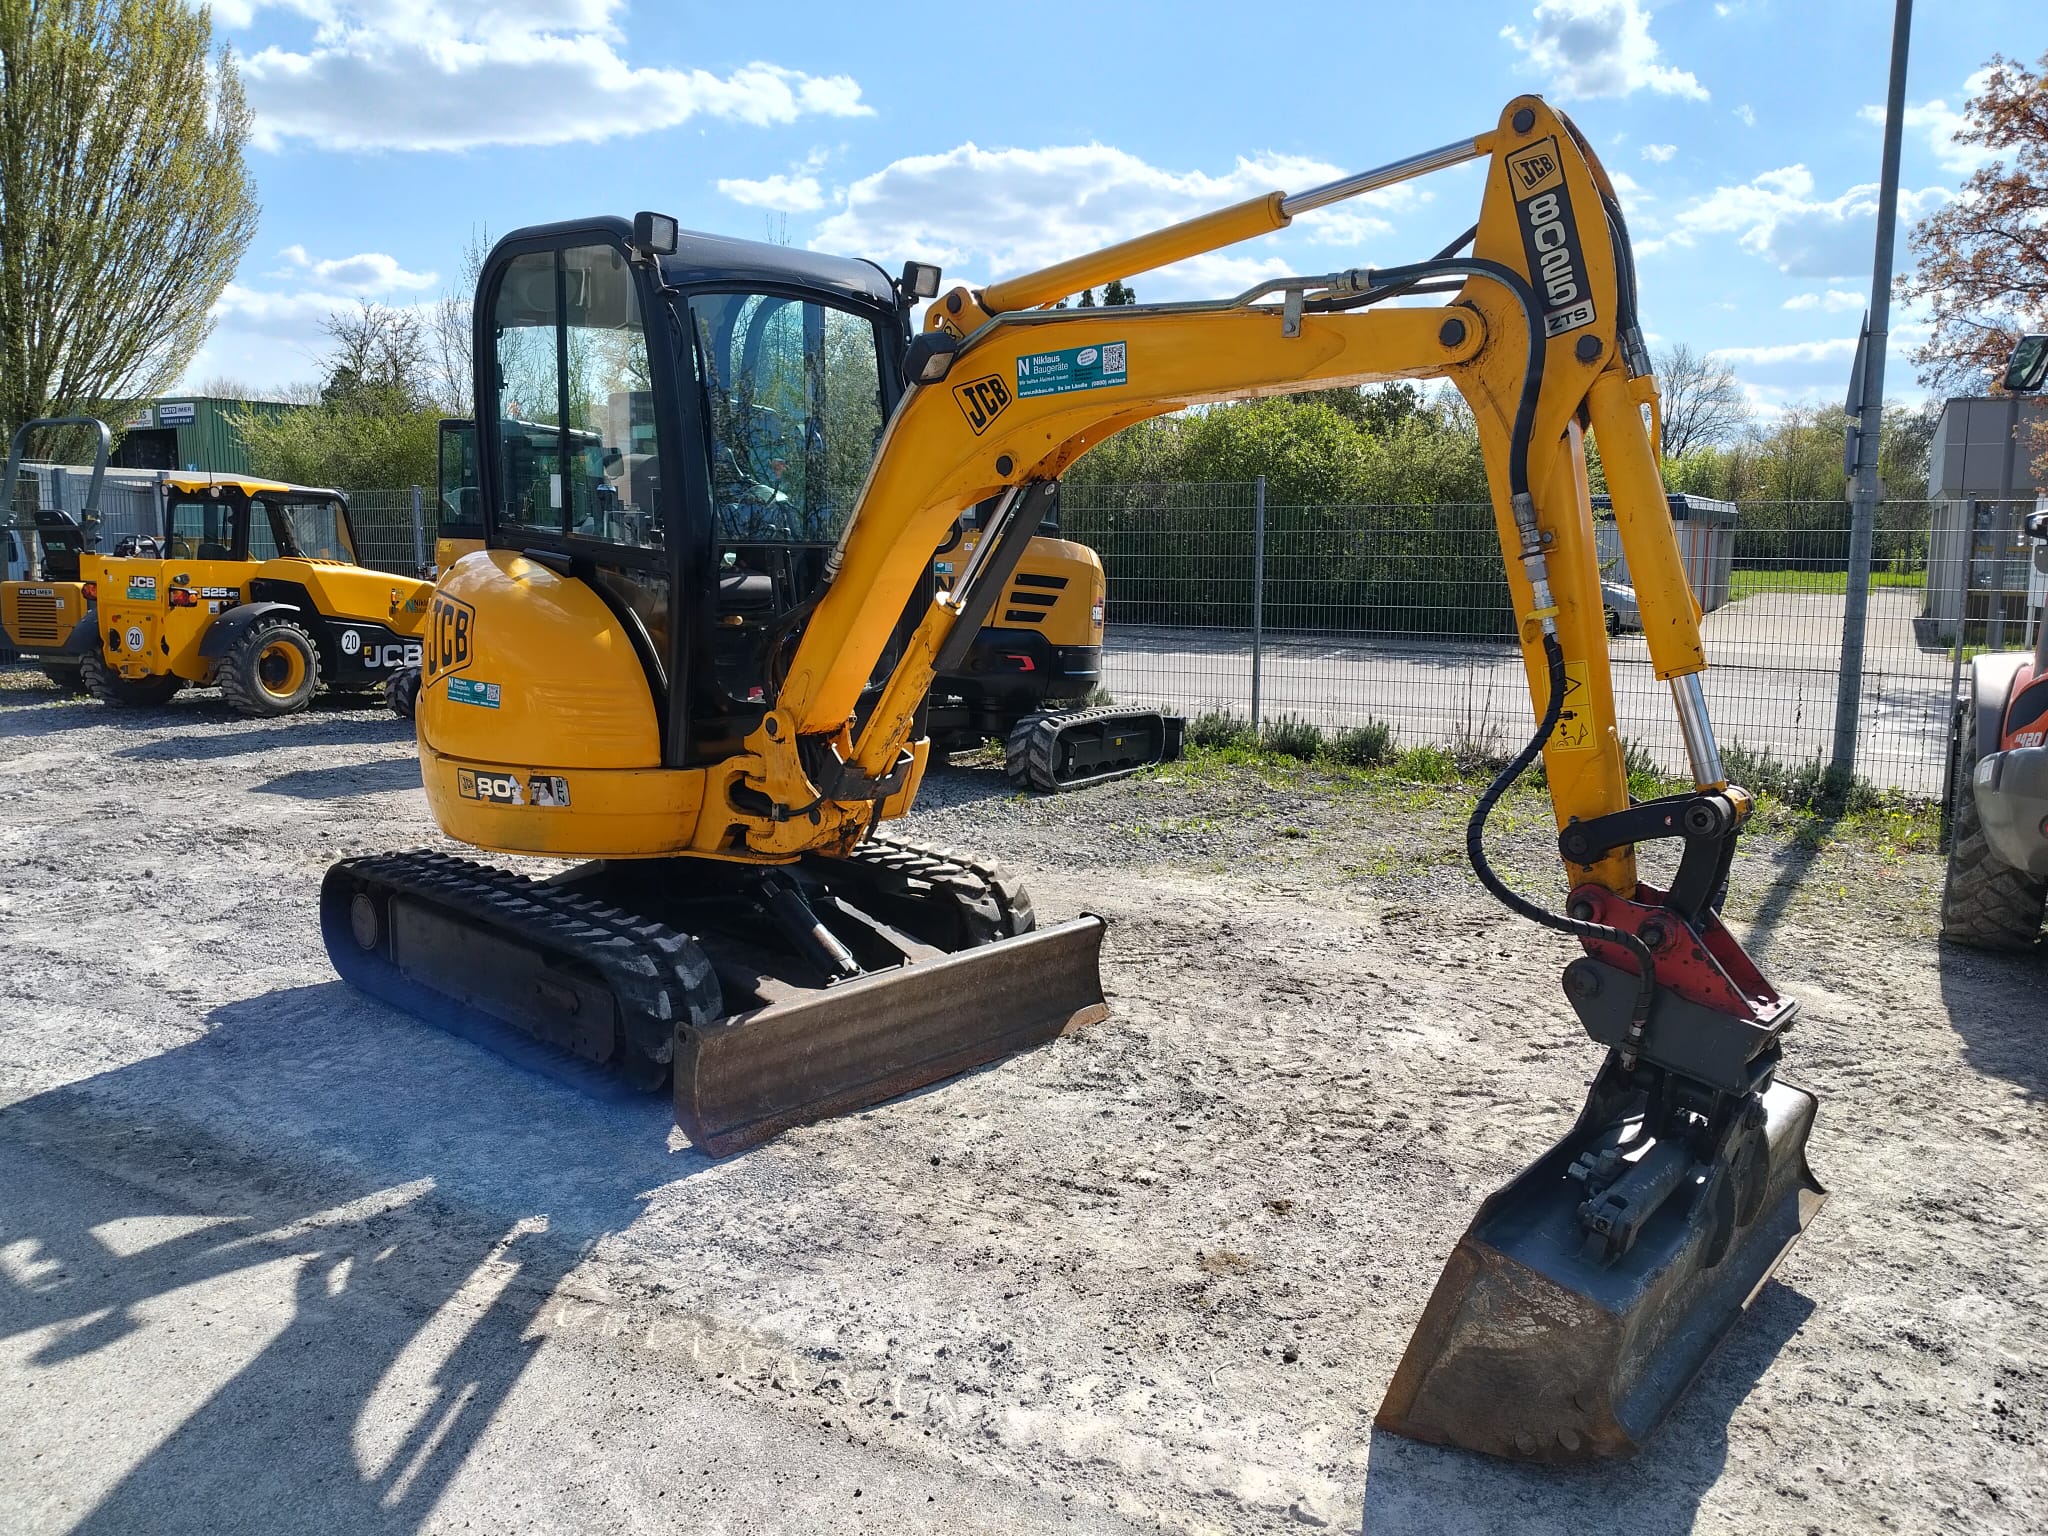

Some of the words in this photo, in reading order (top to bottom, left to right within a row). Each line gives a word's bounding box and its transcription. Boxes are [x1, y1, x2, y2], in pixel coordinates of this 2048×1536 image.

[1519, 156, 1553, 186] JCB
[1528, 193, 1578, 306] 8025
[1548, 307, 1588, 331] ZTS
[1033, 354, 1060, 366] Niklaus
[1033, 362, 1069, 375] Baugeräte
[963, 378, 1009, 429] JCB
[36, 588, 53, 596] IMER
[129, 576, 156, 588] JCB
[129, 632, 141, 646] 20
[345, 634, 357, 650] 20
[428, 599, 469, 676] JCB
[364, 644, 423, 668] JCB
[555, 779, 566, 803] ZTS
